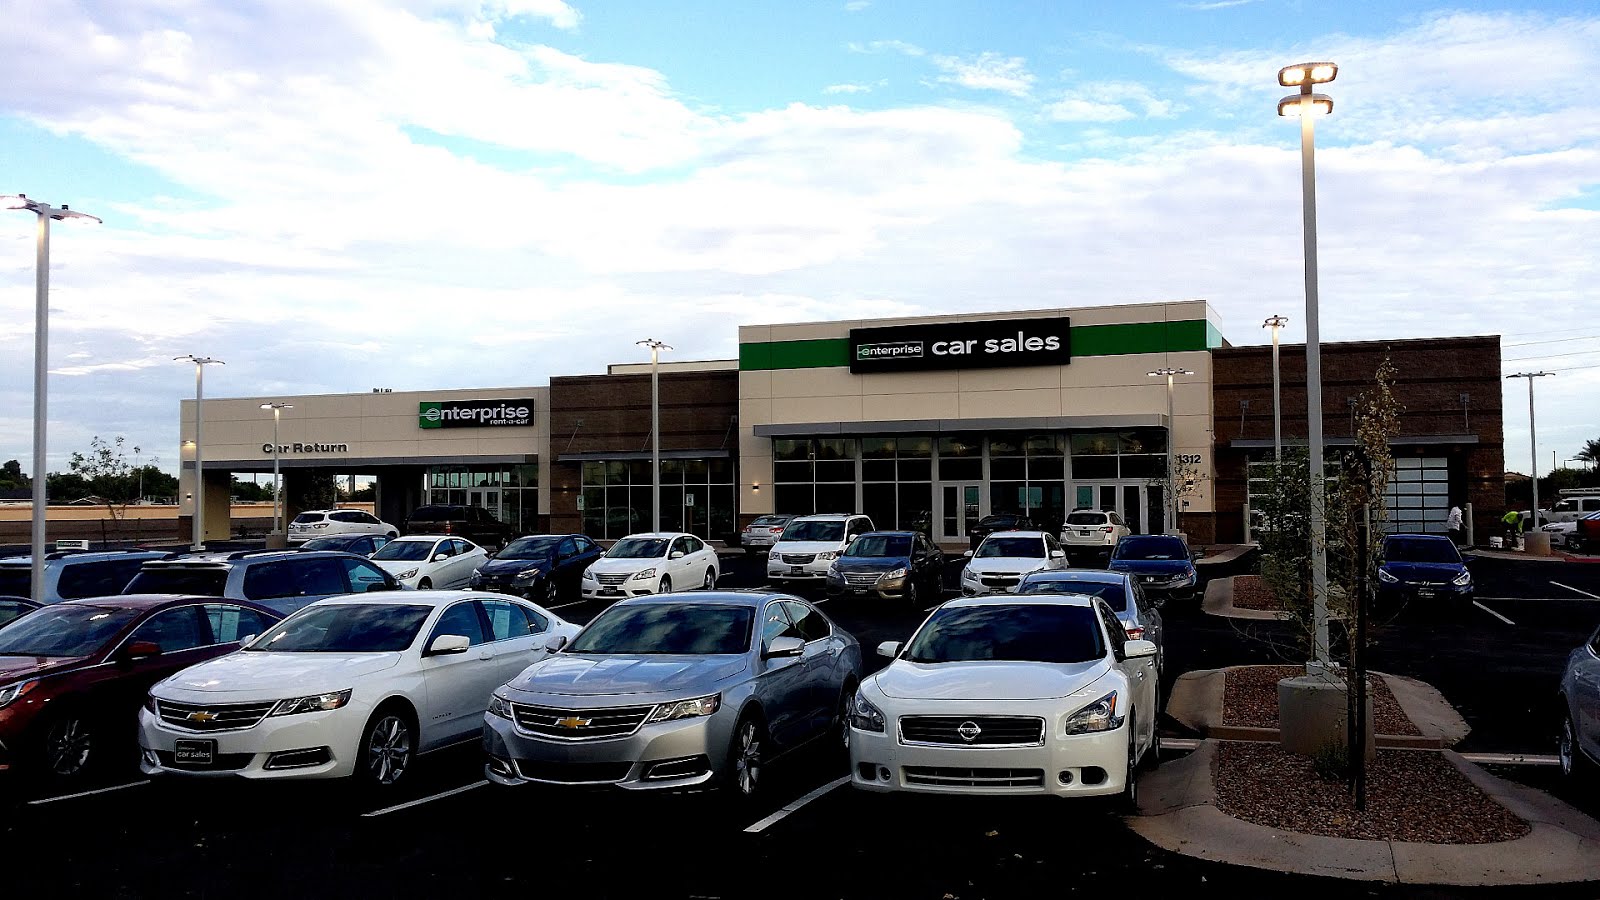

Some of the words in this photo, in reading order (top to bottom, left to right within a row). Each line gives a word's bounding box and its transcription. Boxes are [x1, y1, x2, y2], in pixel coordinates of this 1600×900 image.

[860, 344, 922, 356] enterprise
[931, 339, 978, 355] car
[984, 331, 1060, 353] sales
[421, 403, 530, 423] enterprise
[262, 443, 290, 454] Car
[293, 442, 348, 453] Return
[190, 750, 211, 758] sales
